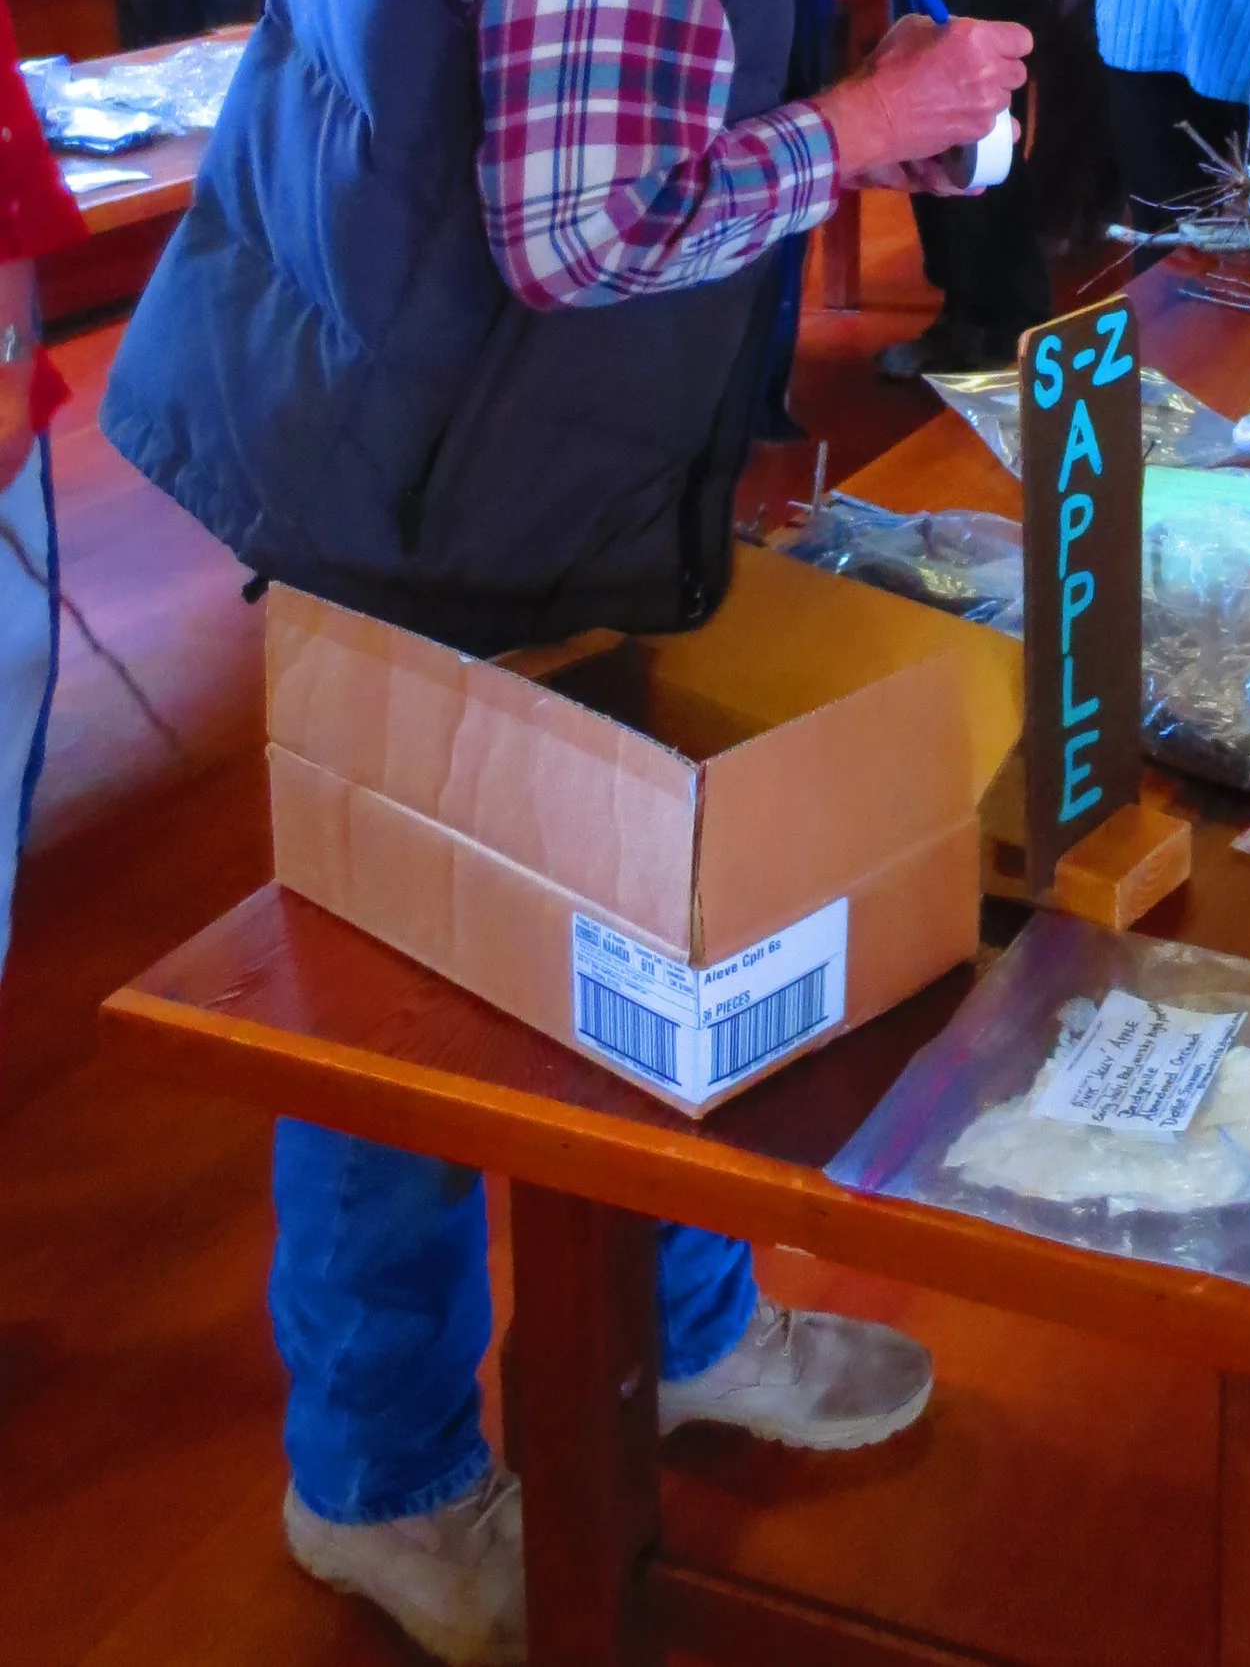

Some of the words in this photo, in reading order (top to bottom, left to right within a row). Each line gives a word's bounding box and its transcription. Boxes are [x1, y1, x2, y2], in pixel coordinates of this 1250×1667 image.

[1034, 310, 1134, 410] S-Z
[1057, 398, 1103, 824] APPLE
[704, 963, 738, 985] Aleve
[716, 990, 751, 1017] PIECES
